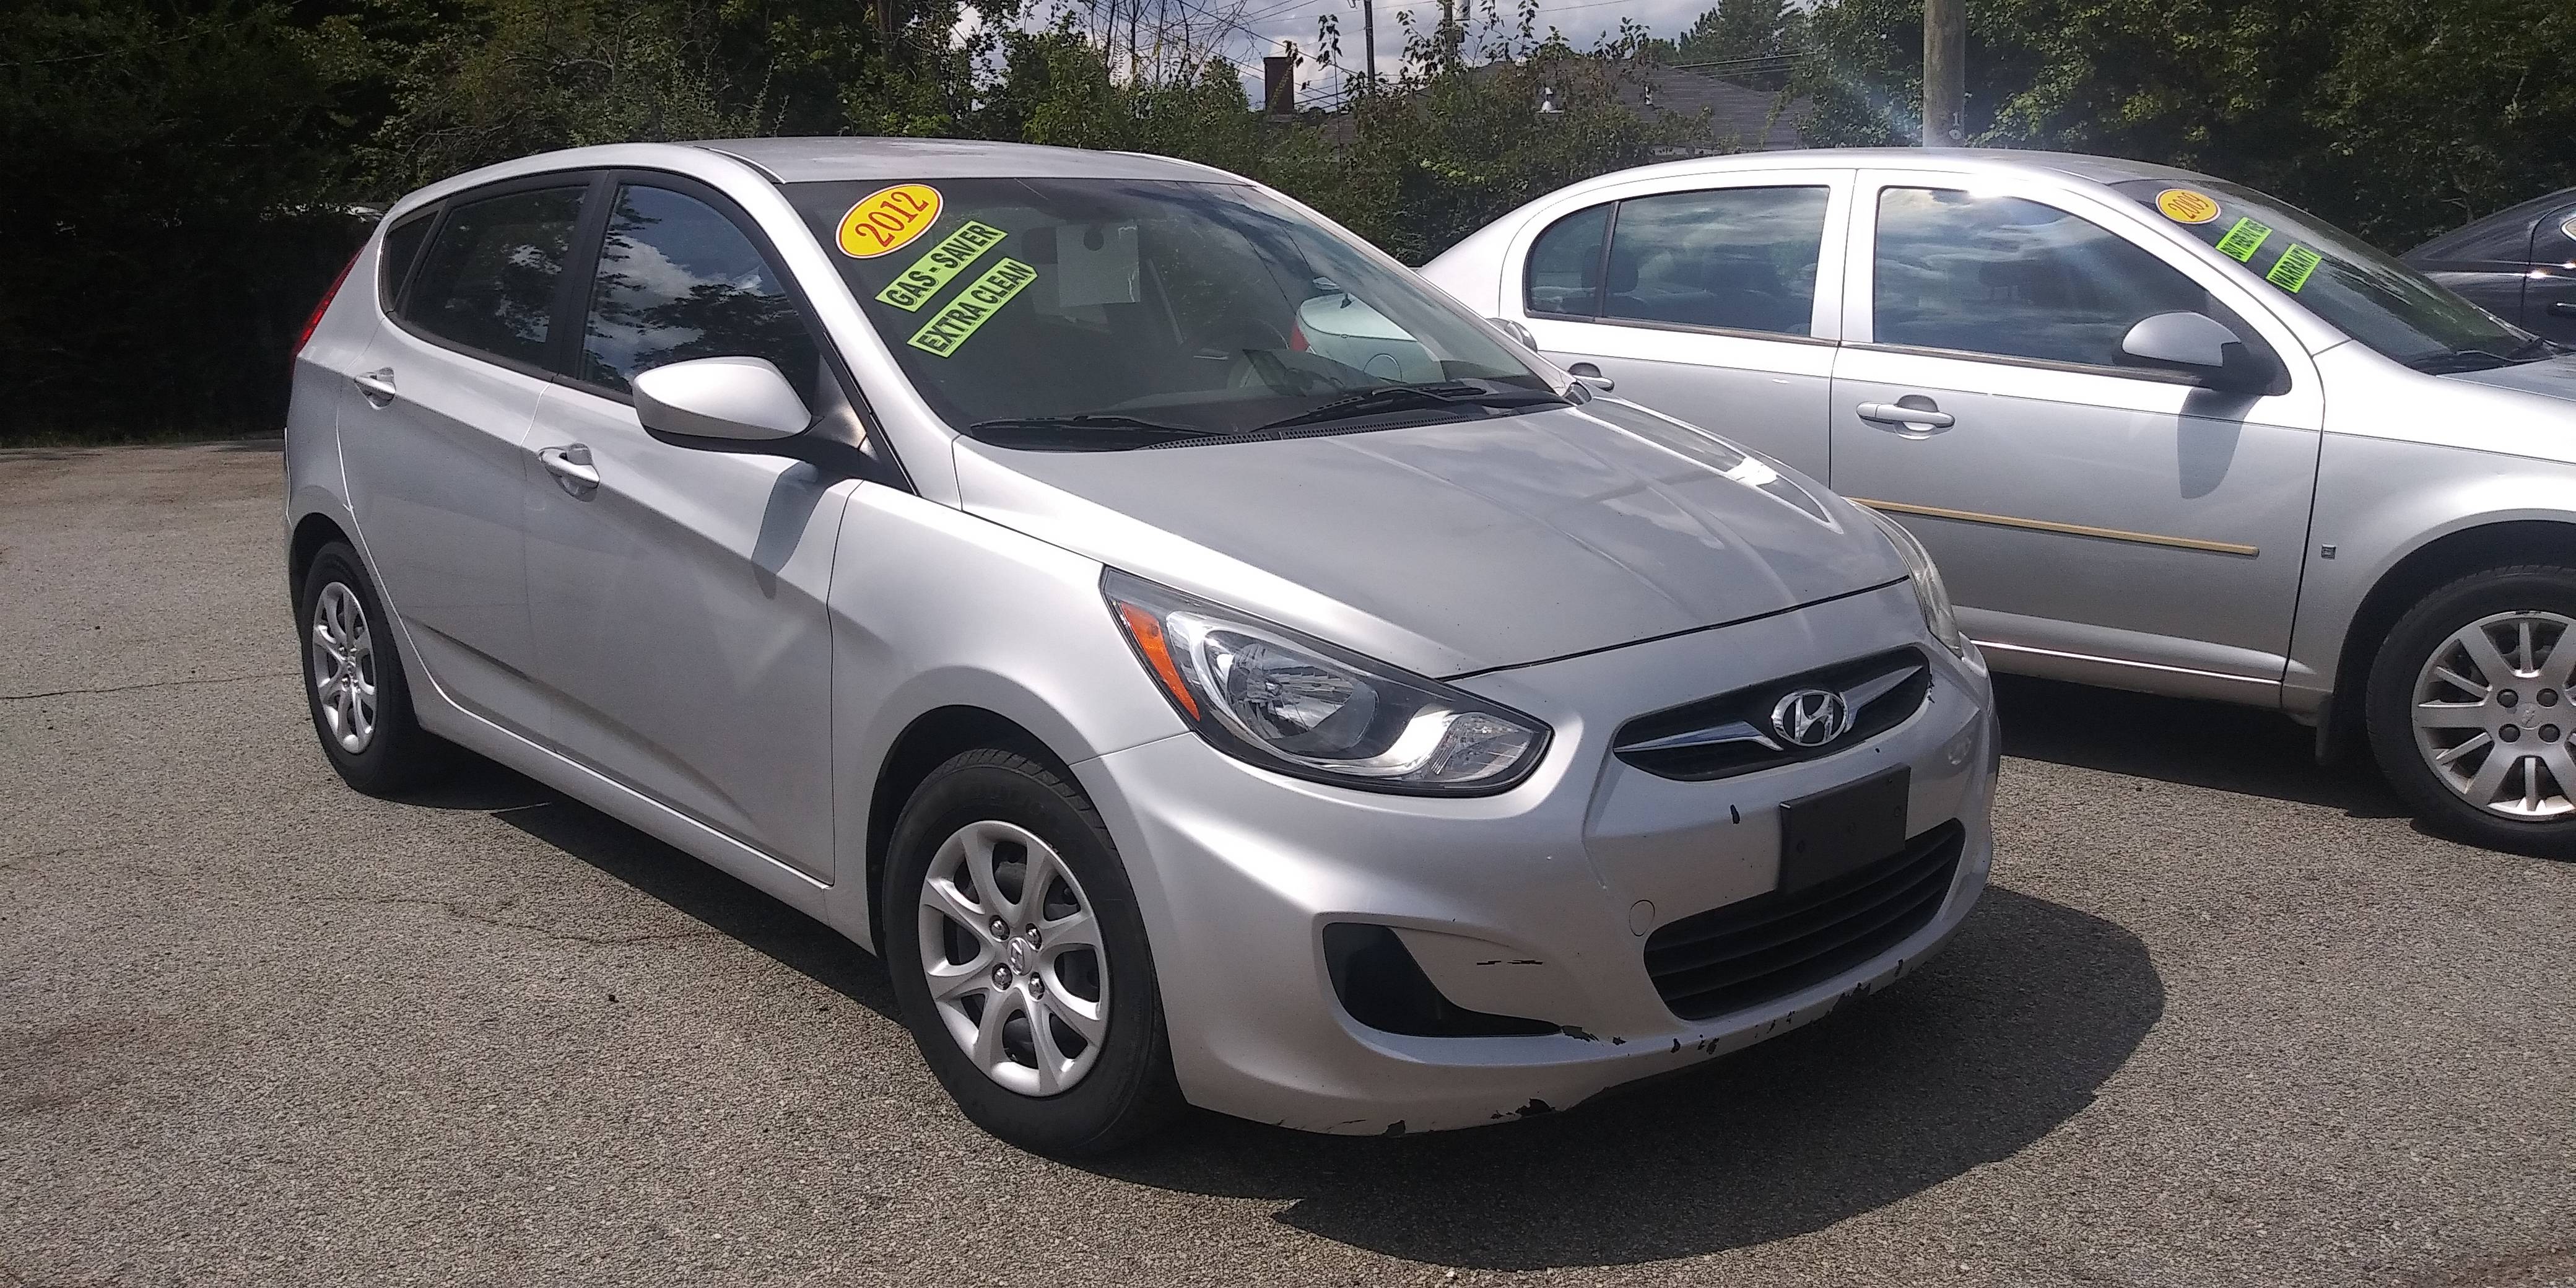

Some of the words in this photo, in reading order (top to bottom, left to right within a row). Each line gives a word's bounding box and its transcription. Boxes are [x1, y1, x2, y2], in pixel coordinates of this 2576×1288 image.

[855, 191, 929, 248] 2012
[2168, 192, 2209, 220] 2009
[886, 271, 939, 307] GAS
[931, 225, 1002, 269] SAVER
[916, 302, 992, 353] EXTRA
[970, 261, 1036, 305] CLEAN
